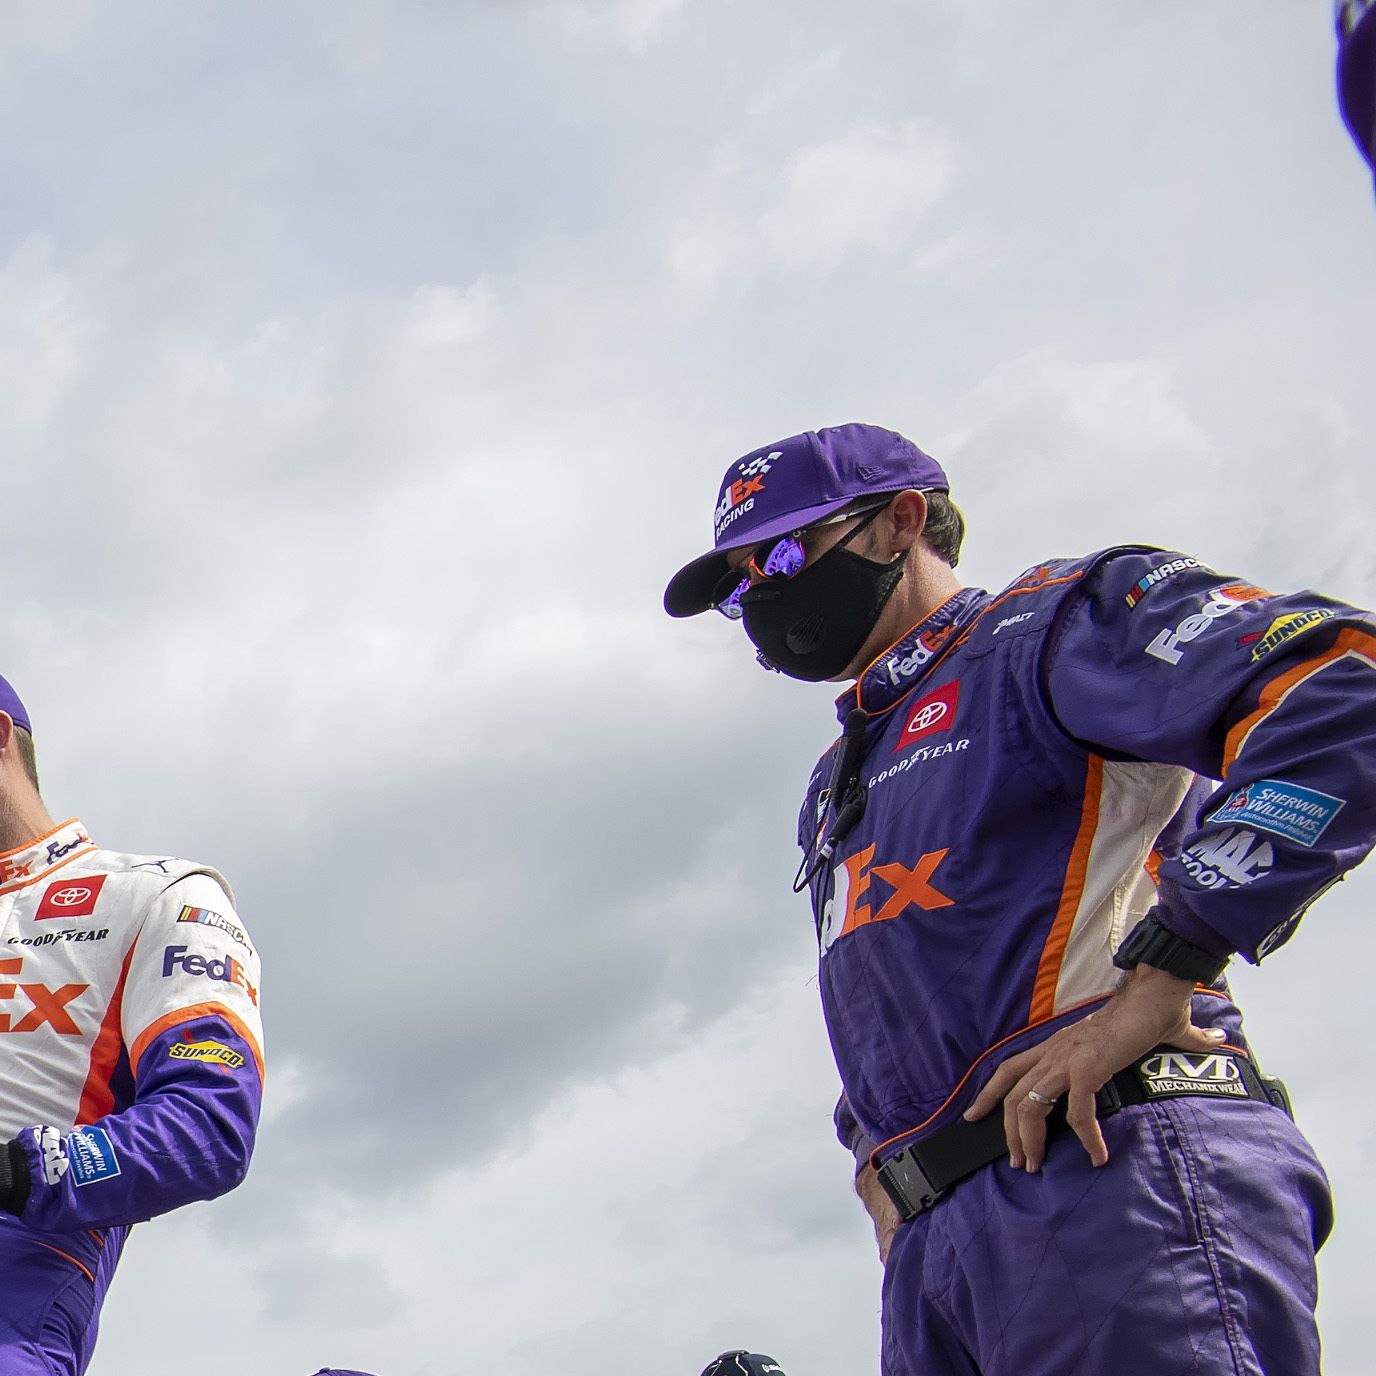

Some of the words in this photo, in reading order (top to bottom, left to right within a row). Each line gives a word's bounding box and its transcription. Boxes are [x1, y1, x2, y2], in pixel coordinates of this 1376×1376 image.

[1253, 608, 1336, 660] SUNOCO
[887, 625, 957, 686] FedEx
[868, 738, 970, 788] GOODYEAR
[1247, 799, 1320, 831] WILLIAMS
[1256, 787, 1330, 819] SHERWIN
[171, 1043, 244, 1068] SUNOCO
